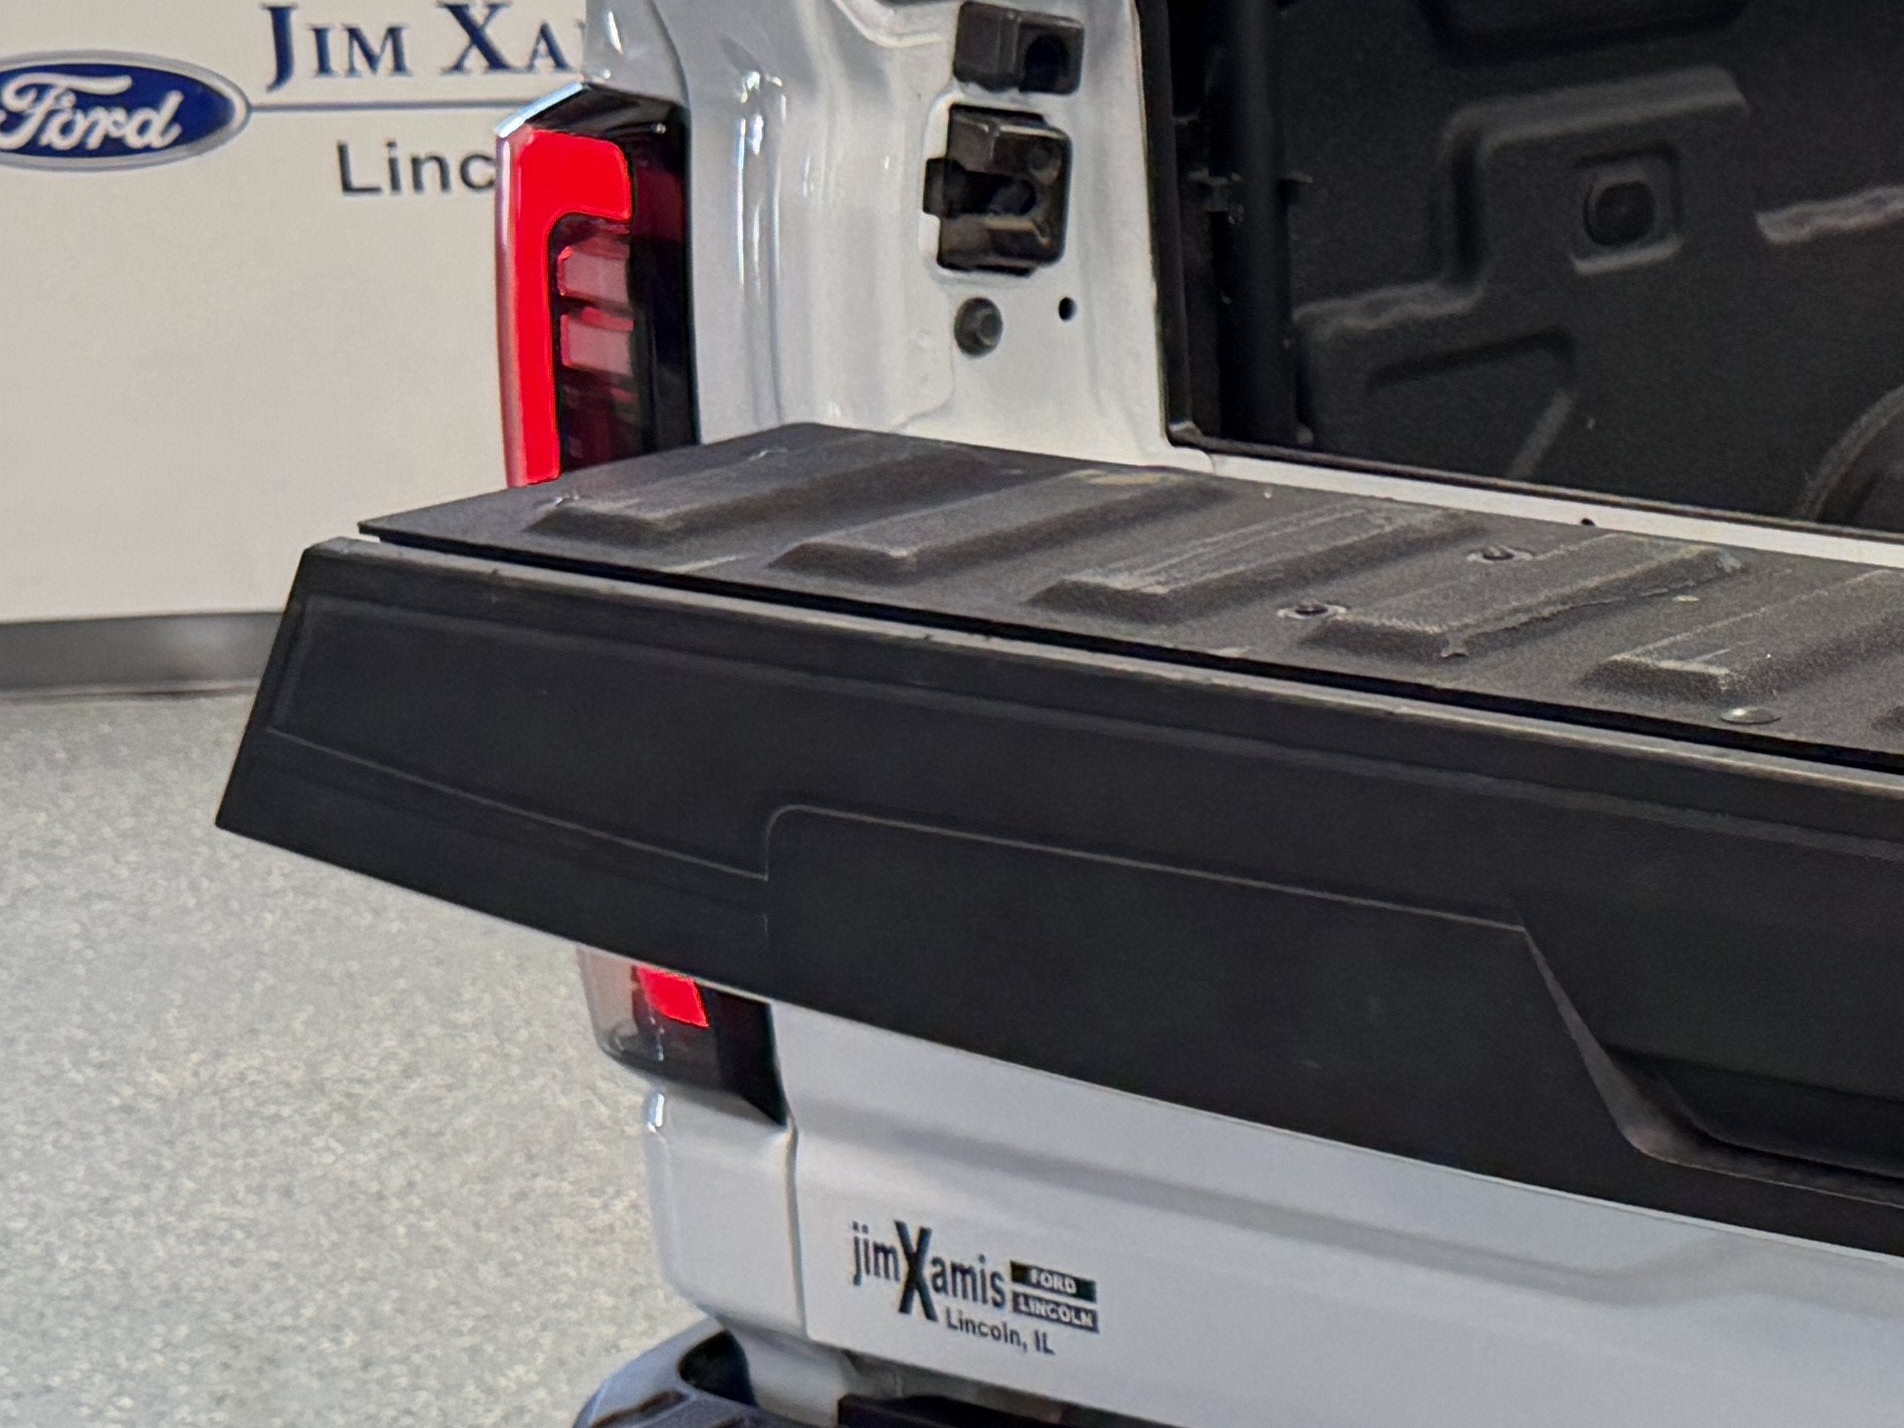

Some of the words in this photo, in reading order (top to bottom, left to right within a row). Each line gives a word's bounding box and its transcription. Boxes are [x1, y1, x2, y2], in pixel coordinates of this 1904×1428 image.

[259, 1, 415, 93] JIM
[0, 72, 183, 152] Ford
[336, 138, 497, 196] Linc
[1028, 1267, 1077, 1296] FORD
[944, 1306, 1028, 1354] Lincoln,
[1034, 1330, 1056, 1356] IL
[1018, 1294, 1095, 1328] LINCOLN
